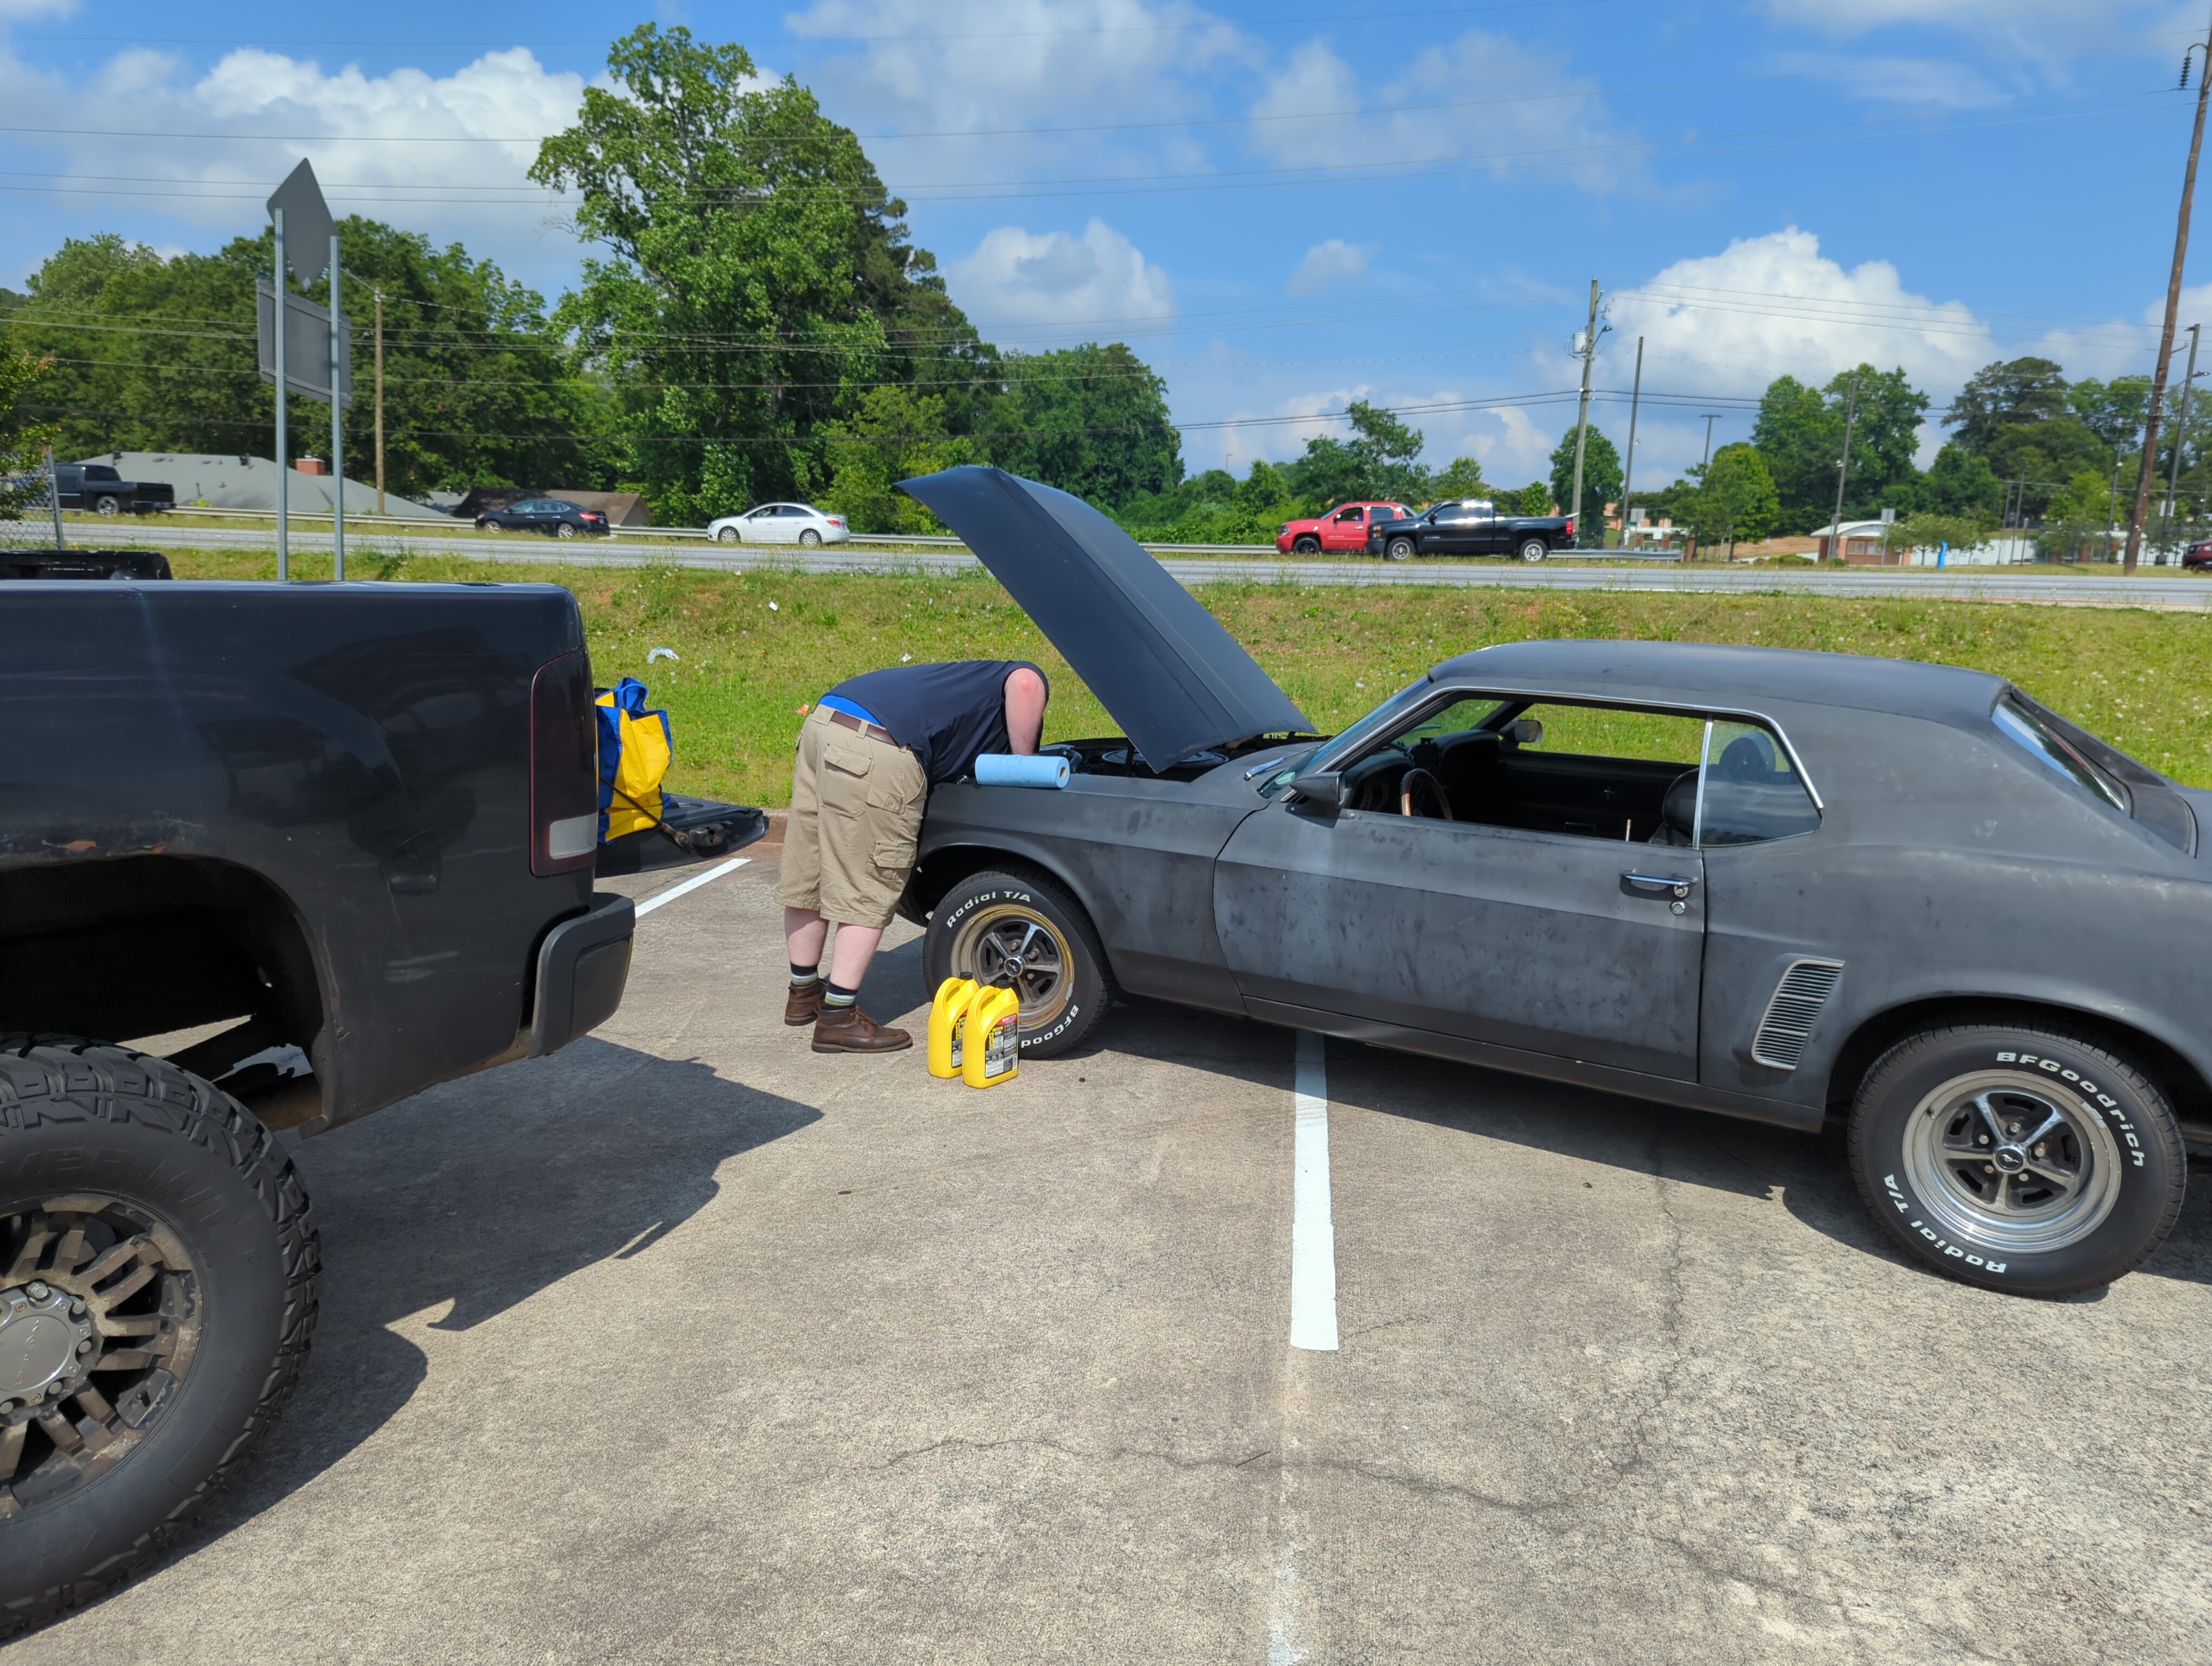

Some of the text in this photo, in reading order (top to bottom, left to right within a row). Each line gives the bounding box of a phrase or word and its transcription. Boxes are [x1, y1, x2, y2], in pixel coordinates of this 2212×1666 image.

[946, 890, 1031, 928] Radial T/A
[1020, 1004, 1079, 1048] BFGood
[1996, 1051, 2145, 1168] BFGoodrich
[1883, 1174, 2007, 1274] Radial T/A
